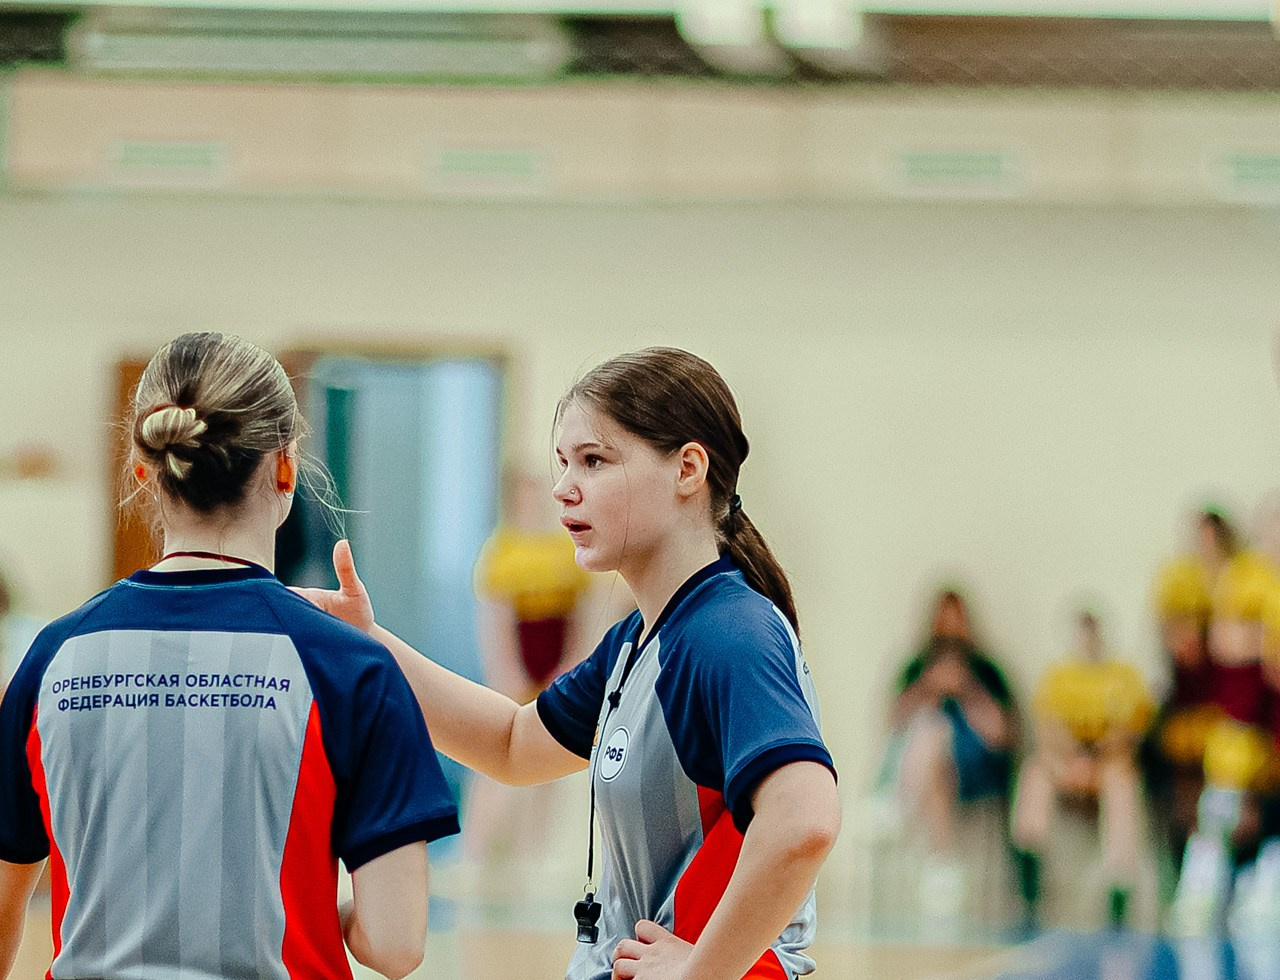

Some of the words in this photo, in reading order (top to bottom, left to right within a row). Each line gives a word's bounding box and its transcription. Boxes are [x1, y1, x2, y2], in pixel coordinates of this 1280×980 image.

[52, 674, 179, 694] ОРЕНБУРГСКАЯ
[185, 674, 291, 692] ОБЛАСТНАЯ
[57, 693, 160, 712] ФЕДЕРАЦИЯ
[165, 694, 277, 710] БАСКЕТБОЛА
[604, 745, 624, 762] РФБ
